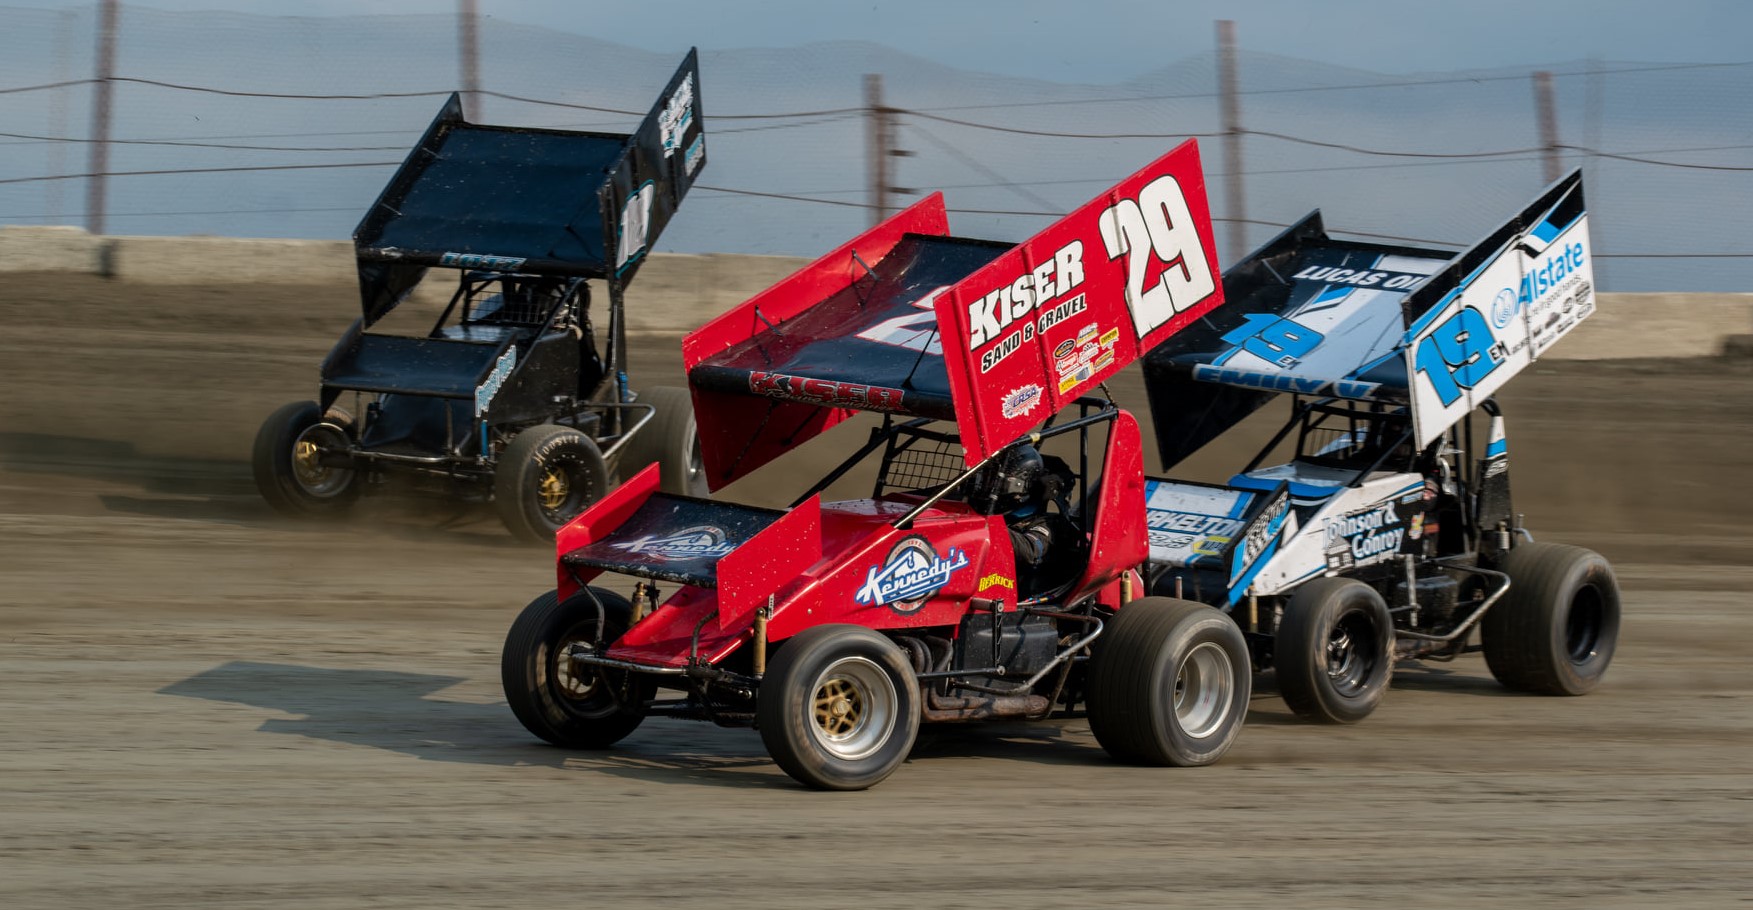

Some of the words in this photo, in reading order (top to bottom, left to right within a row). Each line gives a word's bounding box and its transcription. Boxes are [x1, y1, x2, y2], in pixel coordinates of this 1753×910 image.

[1098, 174, 1216, 340] 29
[1292, 265, 1382, 287] LUCAS
[1516, 241, 1585, 311] Allstate
[968, 239, 1086, 352] KISER
[981, 333, 1022, 373] SAND
[1022, 320, 1035, 341] &
[1036, 293, 1088, 336] GRAVEL
[1220, 312, 1326, 367] 19
[1414, 304, 1506, 410] 19
[1488, 342, 1511, 362] EM
[749, 371, 905, 411] KISER
[1195, 363, 1332, 395] EMILY
[1321, 508, 1385, 550] Johnson
[1384, 500, 1401, 525] &
[1351, 527, 1405, 560] Conroy
[854, 546, 970, 608] Kennedy's
